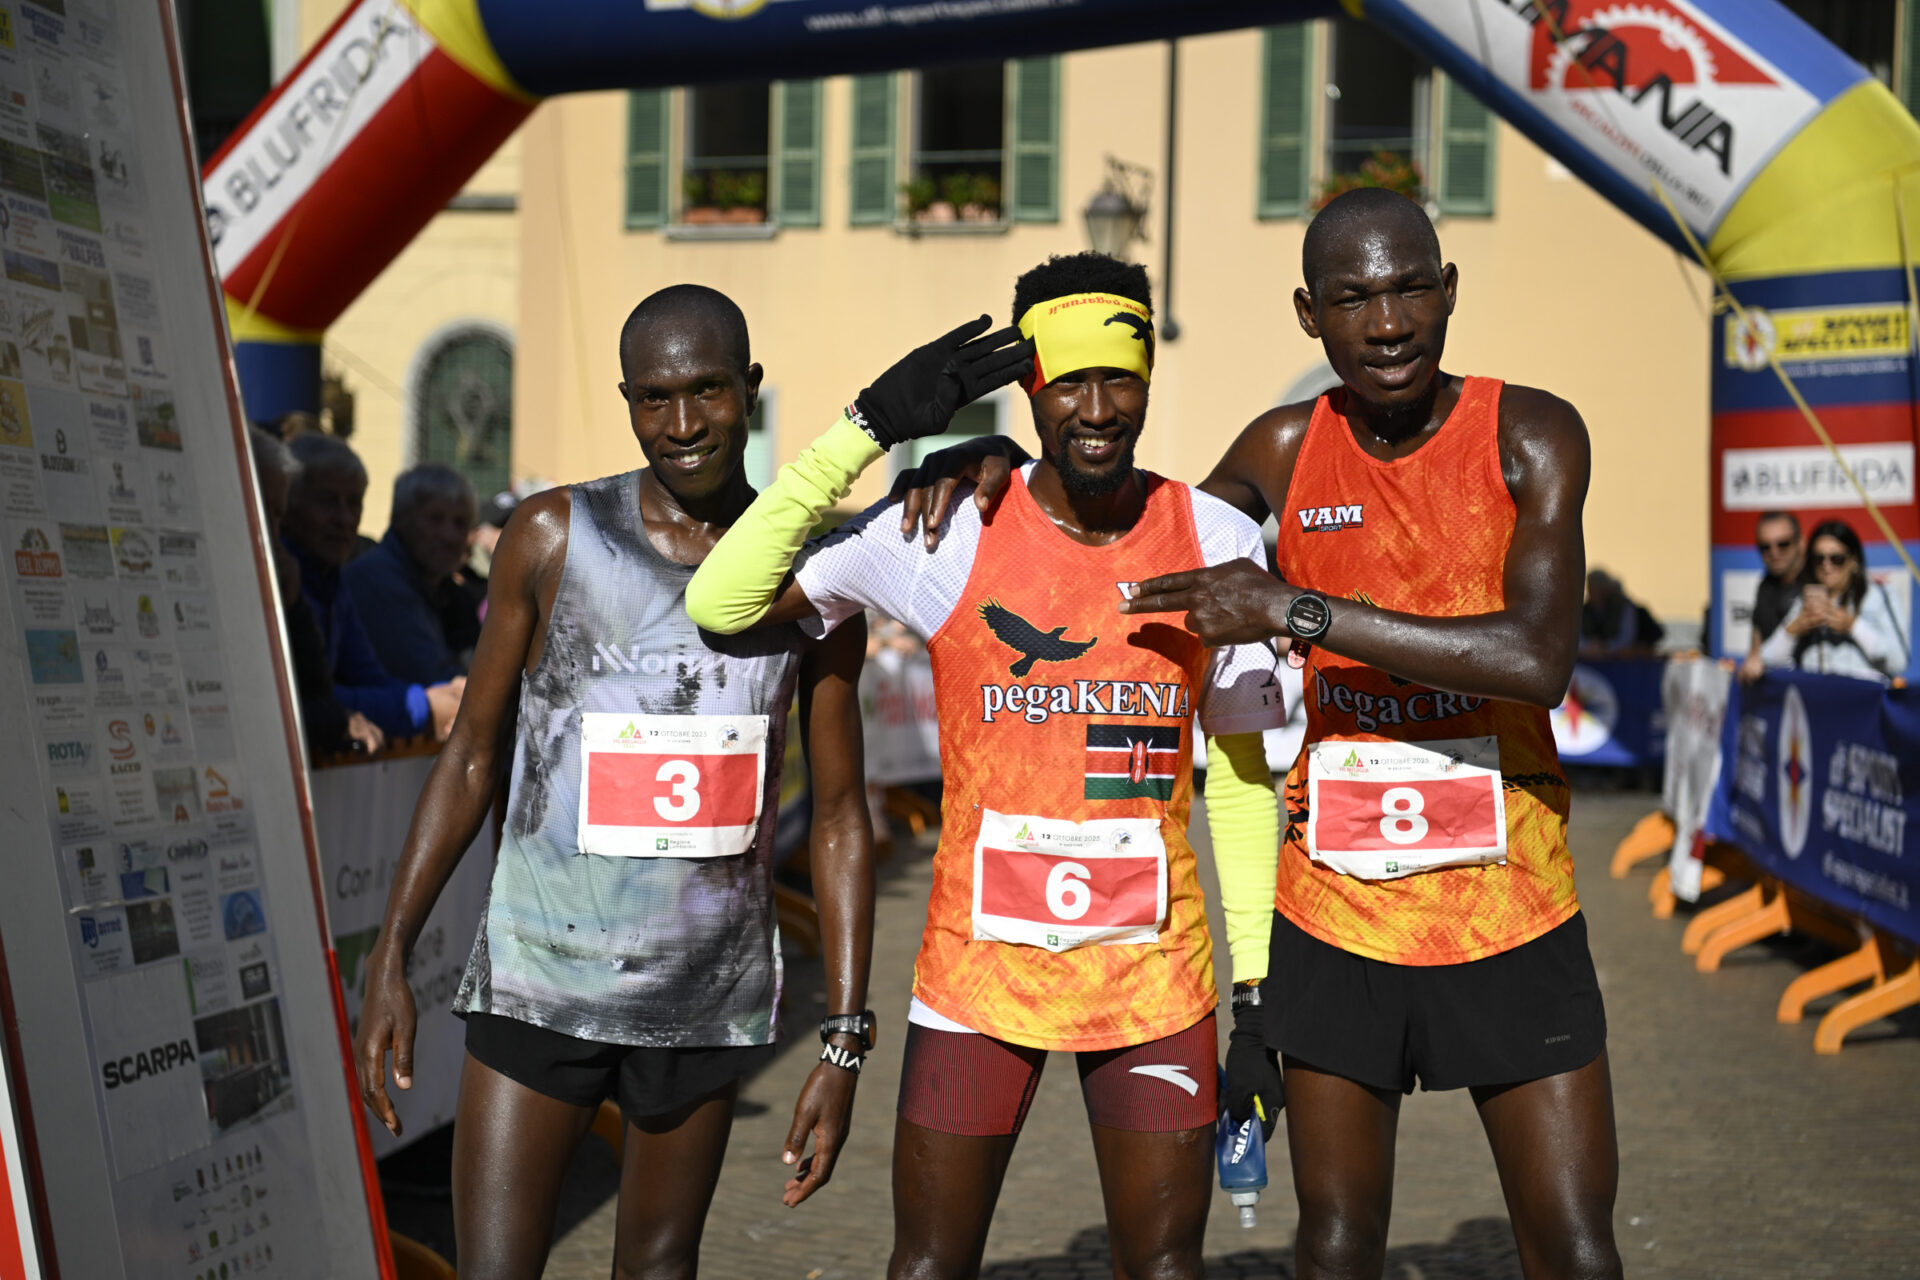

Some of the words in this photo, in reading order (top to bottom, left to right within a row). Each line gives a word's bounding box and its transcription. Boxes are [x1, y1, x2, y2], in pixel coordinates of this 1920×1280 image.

[1755, 458, 1906, 496] BLUFRIDA
[1298, 504, 1363, 528] VAM
[1319, 524, 1343, 532] SPORT
[1312, 664, 1488, 733] pegaCRO
[653, 759, 701, 822] 3
[1379, 787, 1429, 844] 8
[1046, 861, 1091, 920] 6
[103, 1039, 196, 1090] SCARPA
